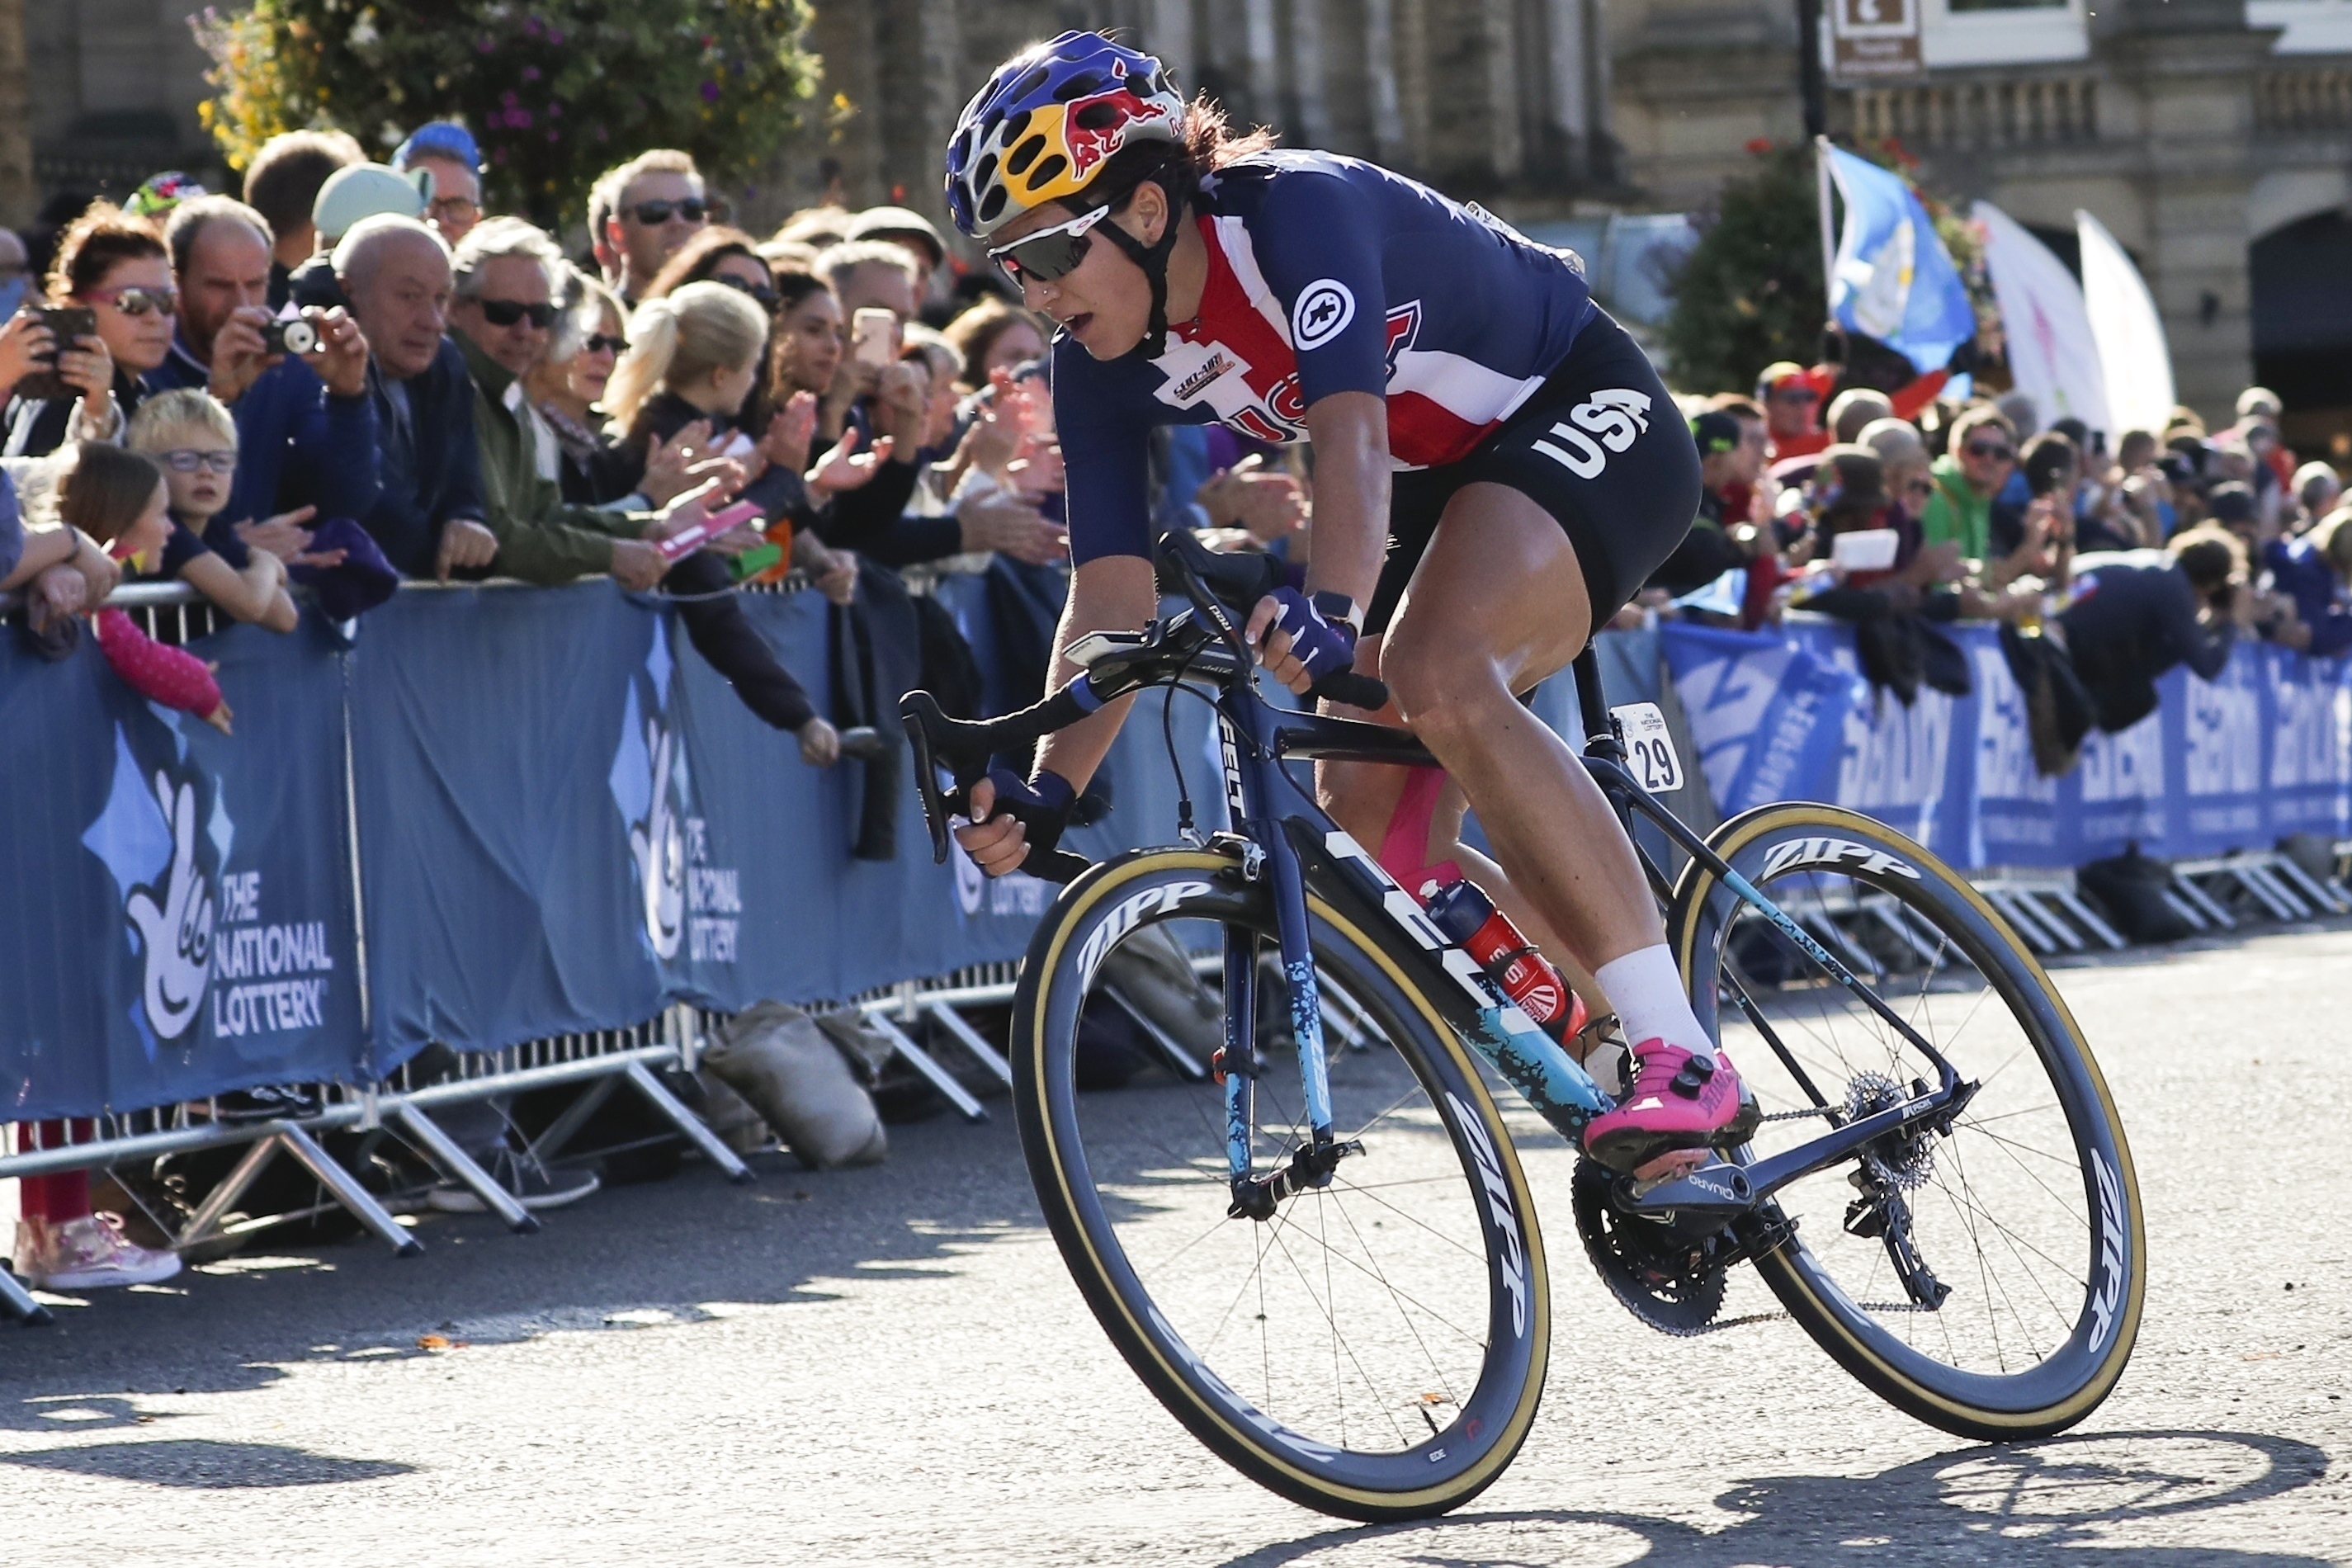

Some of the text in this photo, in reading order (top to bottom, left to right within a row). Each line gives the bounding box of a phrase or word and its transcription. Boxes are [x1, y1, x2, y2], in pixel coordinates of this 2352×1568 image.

[1531, 389, 1652, 479] USA
[1219, 715, 1247, 819] FELT
[1635, 738, 1674, 789] 29
[220, 871, 260, 923] THE
[1762, 836, 1922, 881] ZIPP
[214, 921, 333, 980] NATIONAL
[1076, 881, 1213, 995] ZIPP
[1325, 830, 1542, 1036] FELT
[215, 979, 324, 1038] LOTTERY
[1445, 1090, 1526, 1339] ZIPP
[1688, 1174, 1736, 1202] QUARQ
[2089, 1147, 2123, 1353] ZIPP
[1146, 1306, 1343, 1464] ZIPP
